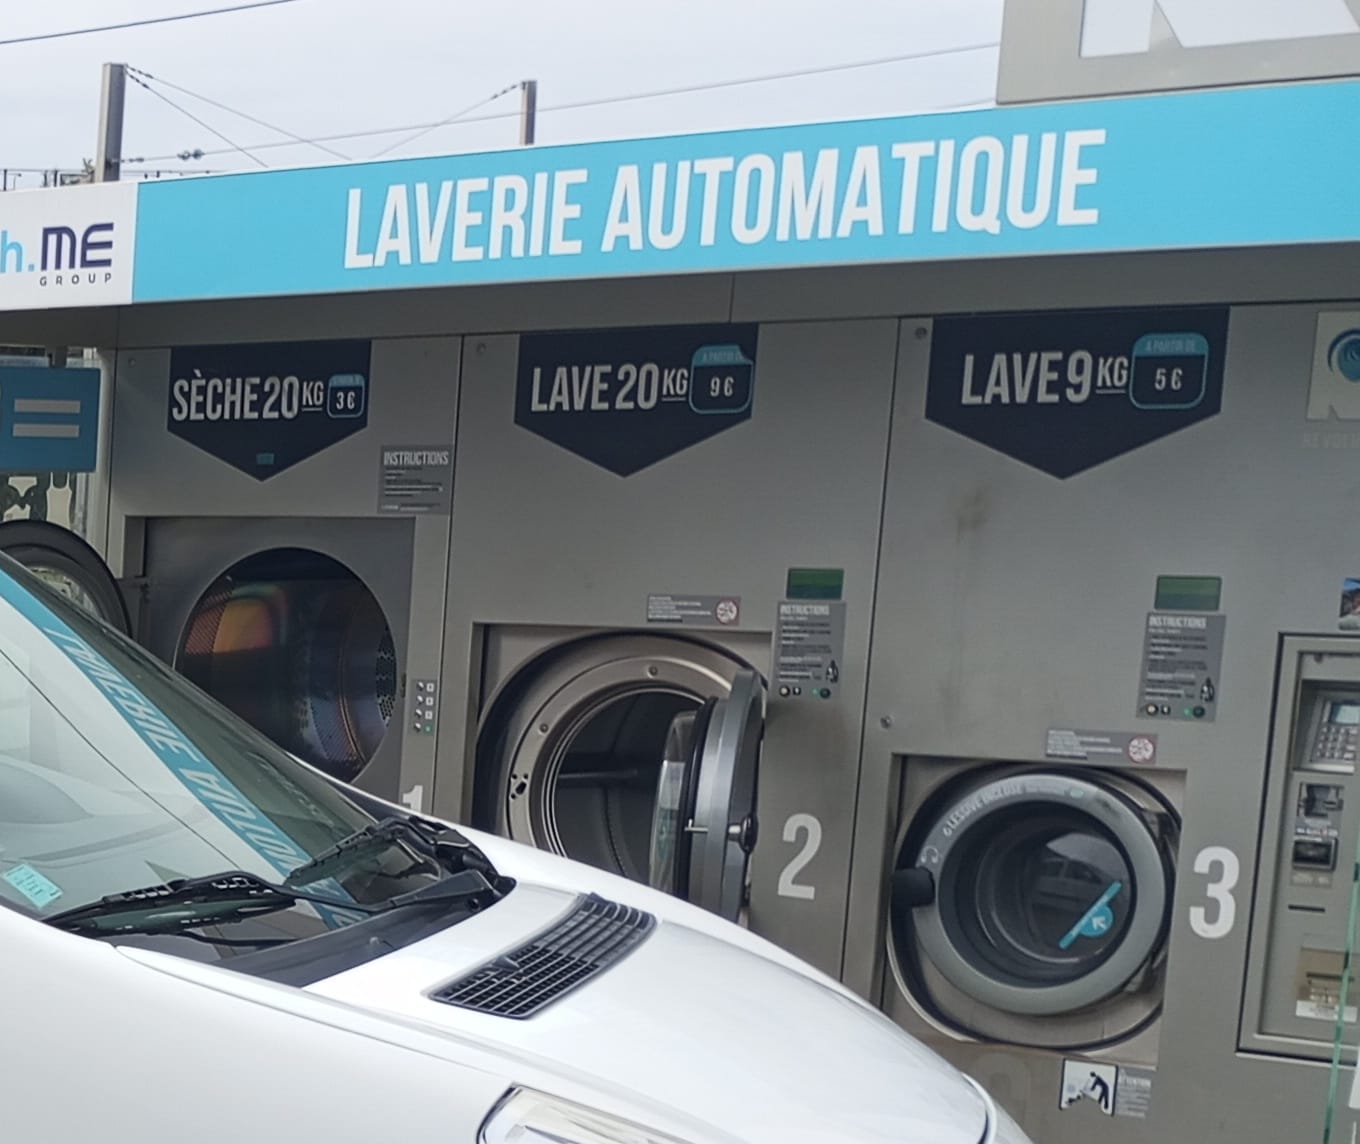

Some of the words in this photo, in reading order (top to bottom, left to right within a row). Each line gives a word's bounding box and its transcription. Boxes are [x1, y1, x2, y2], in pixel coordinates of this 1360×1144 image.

[344, 168, 588, 269] LAVERIE
[601, 129, 1106, 253] AUTOMATIQUE
[39, 272, 112, 286] GROUP
[172, 369, 260, 420] SÈCHE
[531, 365, 612, 411] LAVE
[962, 352, 1062, 404] LAVE
[384, 450, 449, 466] INSTRUCTIONS
[779, 604, 830, 616] INSTRUCTIONS
[1148, 616, 1207, 628] INSTRUCTIONS
[778, 813, 823, 900] 2
[1189, 846, 1240, 939] 3
